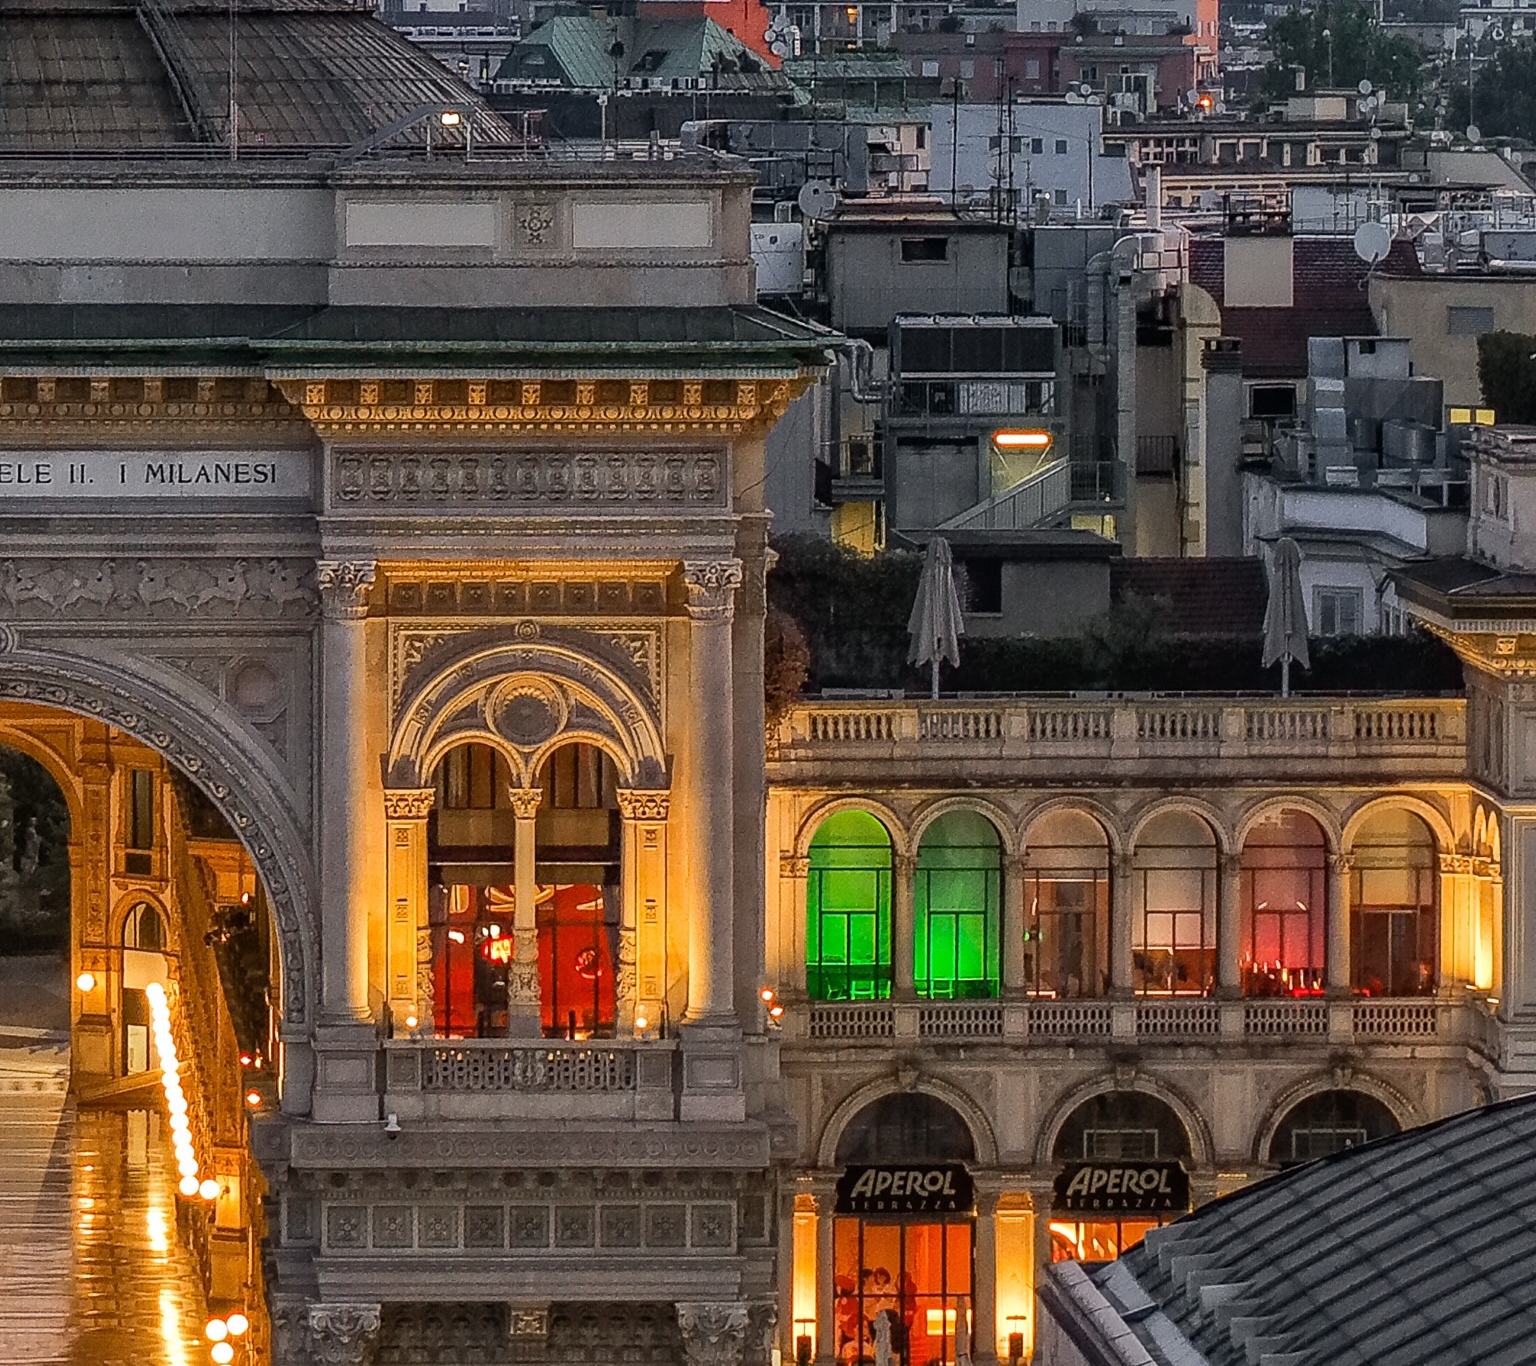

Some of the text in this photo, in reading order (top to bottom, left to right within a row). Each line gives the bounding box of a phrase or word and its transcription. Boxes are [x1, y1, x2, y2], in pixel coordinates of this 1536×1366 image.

[120, 463, 126, 484] I
[144, 463, 277, 485] MILANESI
[850, 1168, 957, 1198] APEROL
[1066, 1166, 1172, 1196] APEROL
[851, 1200, 956, 1210] TERRAZZA
[1066, 1198, 1172, 1208] TERRAZZA
